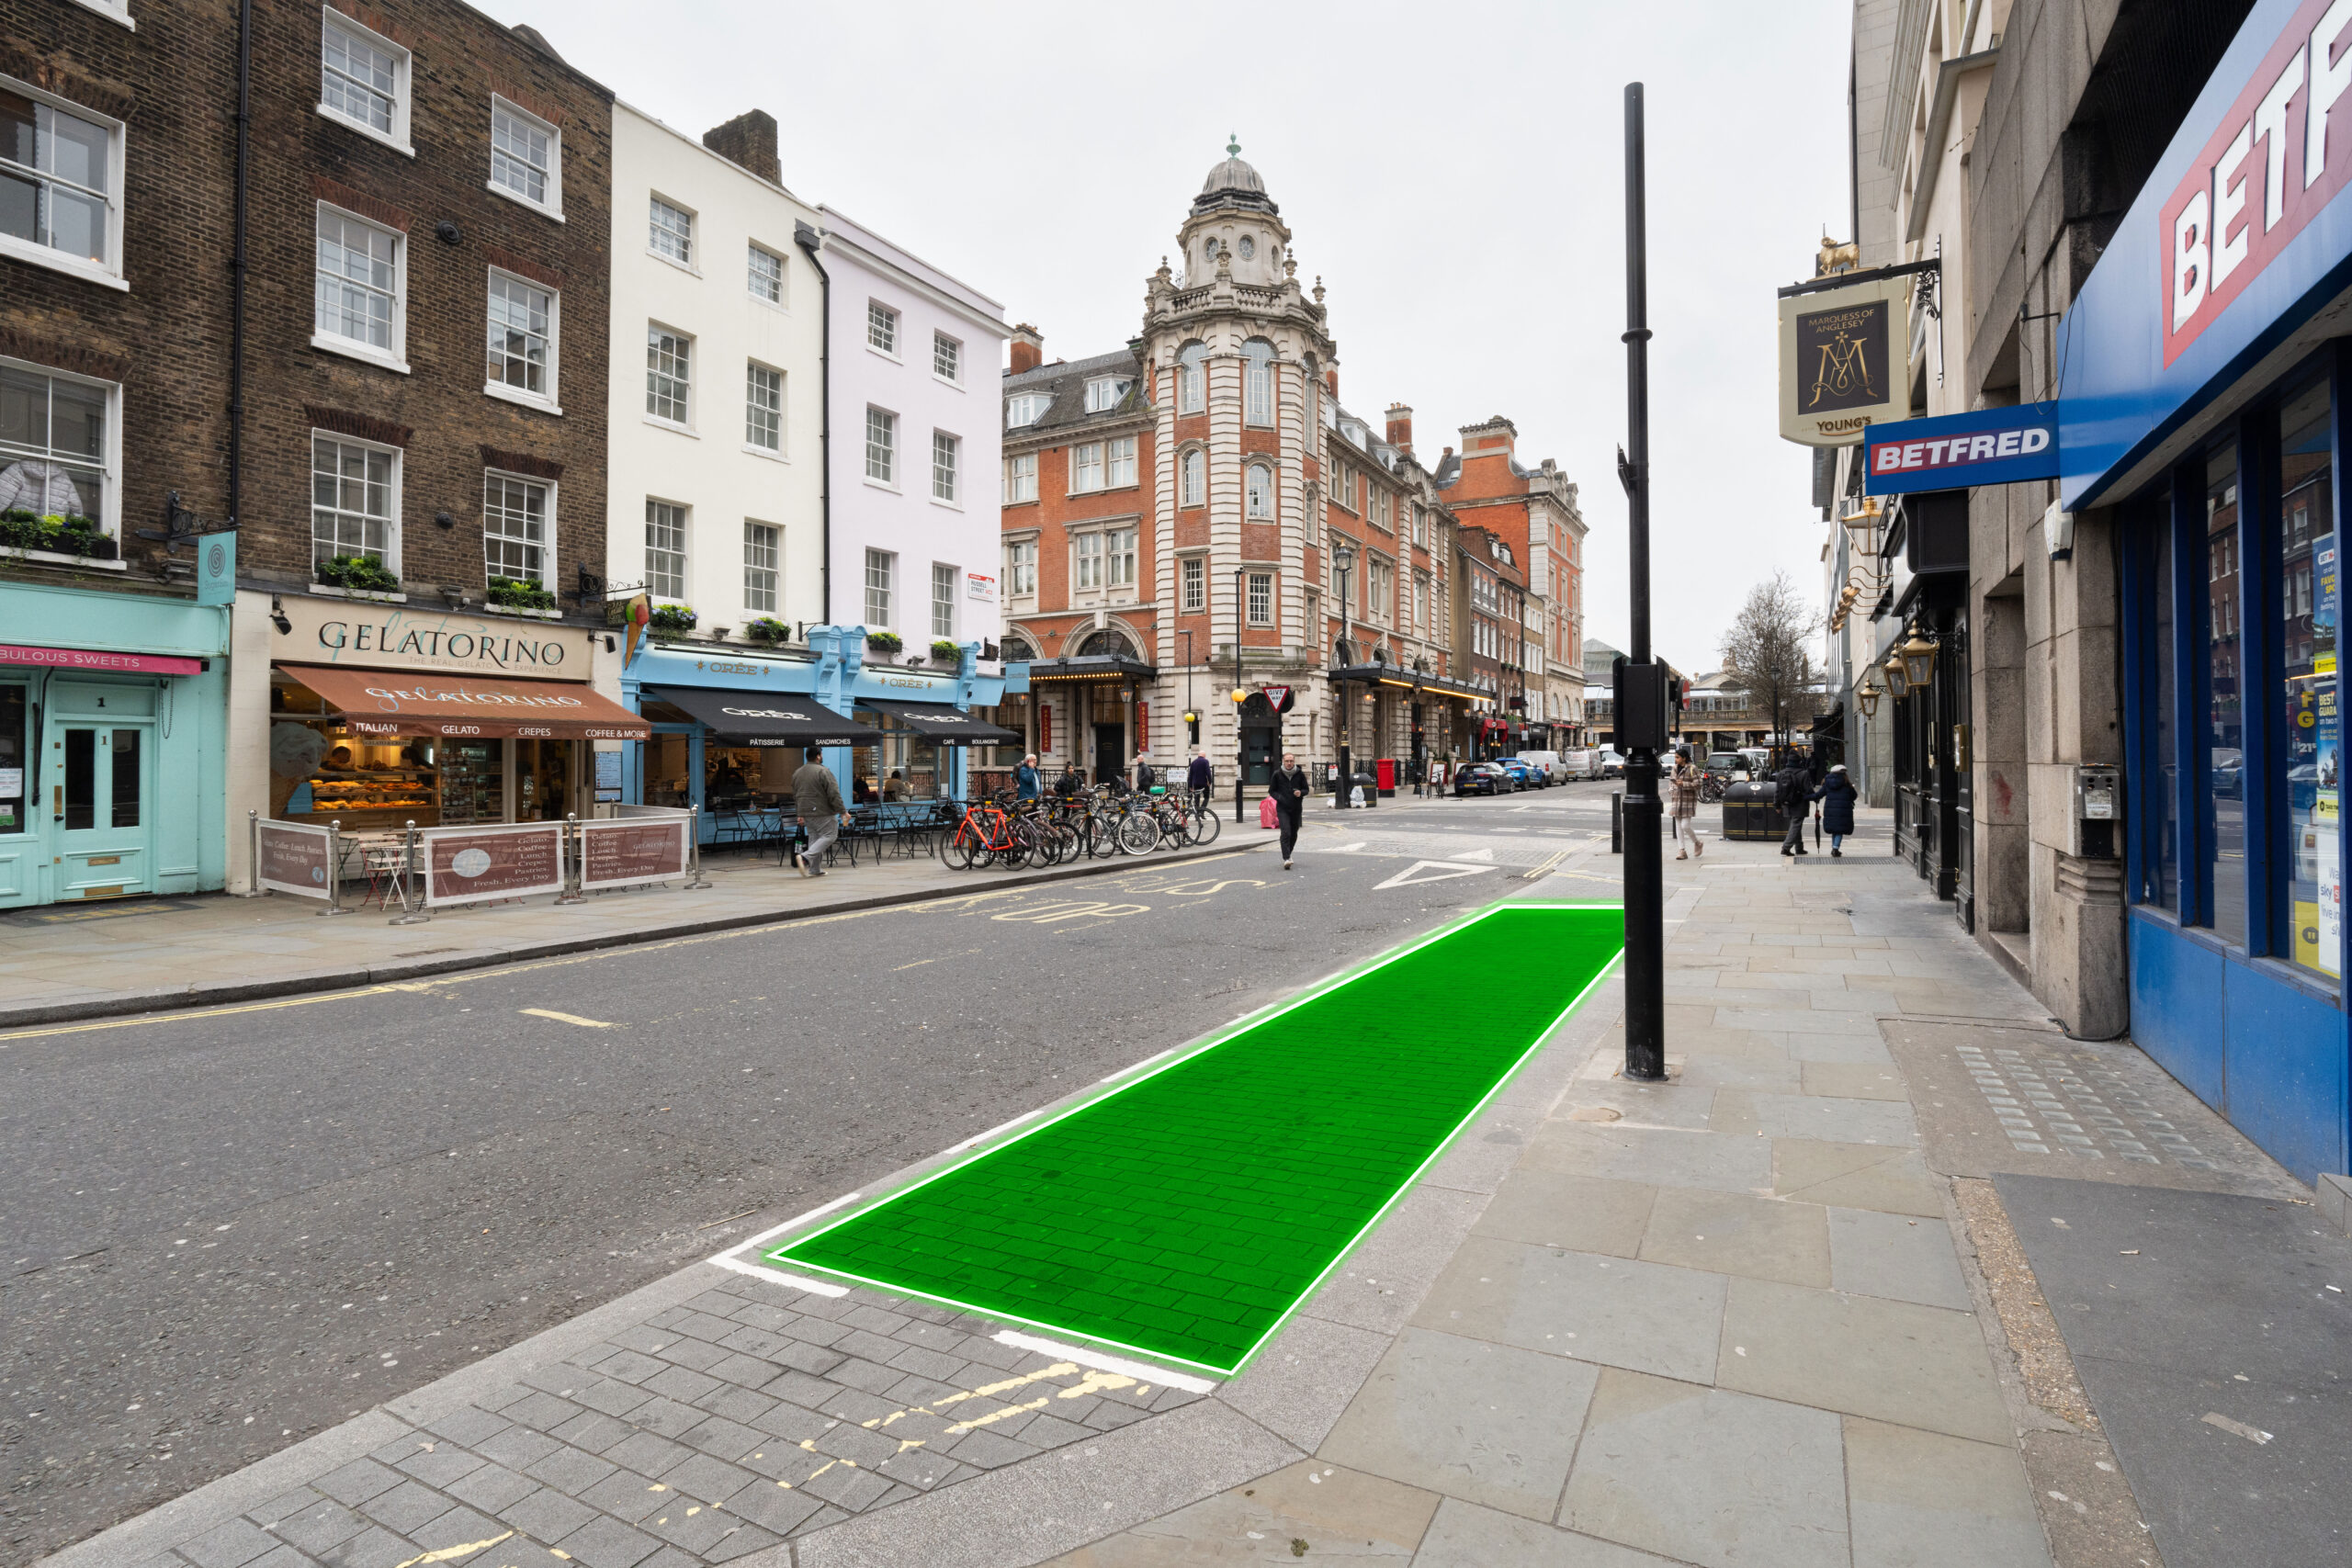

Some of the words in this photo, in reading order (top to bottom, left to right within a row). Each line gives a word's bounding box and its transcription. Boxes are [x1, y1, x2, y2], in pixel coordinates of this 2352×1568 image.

[1808, 310, 1860, 327] MARQUESS
[1860, 309, 1874, 319] OF
[1815, 319, 1865, 333] ANGLESEY
[1817, 415, 1872, 432] YOUNG'S
[1876, 428, 2050, 471] BETFRED
[970, 580, 987, 589] RUSSELL
[970, 586, 984, 594] STREET
[318, 621, 565, 669] GELATORINO
[74, 653, 141, 668] SWEETS
[431, 659, 453, 667] REAL
[458, 660, 492, 670] GELATO
[514, 664, 563, 675] EXPERIENCE
[97, 696, 106, 707] 1
[2318, 694, 2335, 706] BEST
[355, 722, 398, 733] ITALIAN
[441, 725, 481, 736] GELATO
[518, 727, 551, 737] CREPES
[585, 728, 615, 738] COFFEE
[624, 730, 646, 739] MORE
[102, 735, 107, 745] 1
[749, 738, 786, 746] PÂTISSERIE
[815, 738, 851, 746] SANDWICHES
[617, 866, 639, 874] Every
[504, 875, 530, 885] Every
[532, 873, 549, 881] Day
[2320, 884, 2333, 900] sky
[2321, 904, 2333, 919] live
